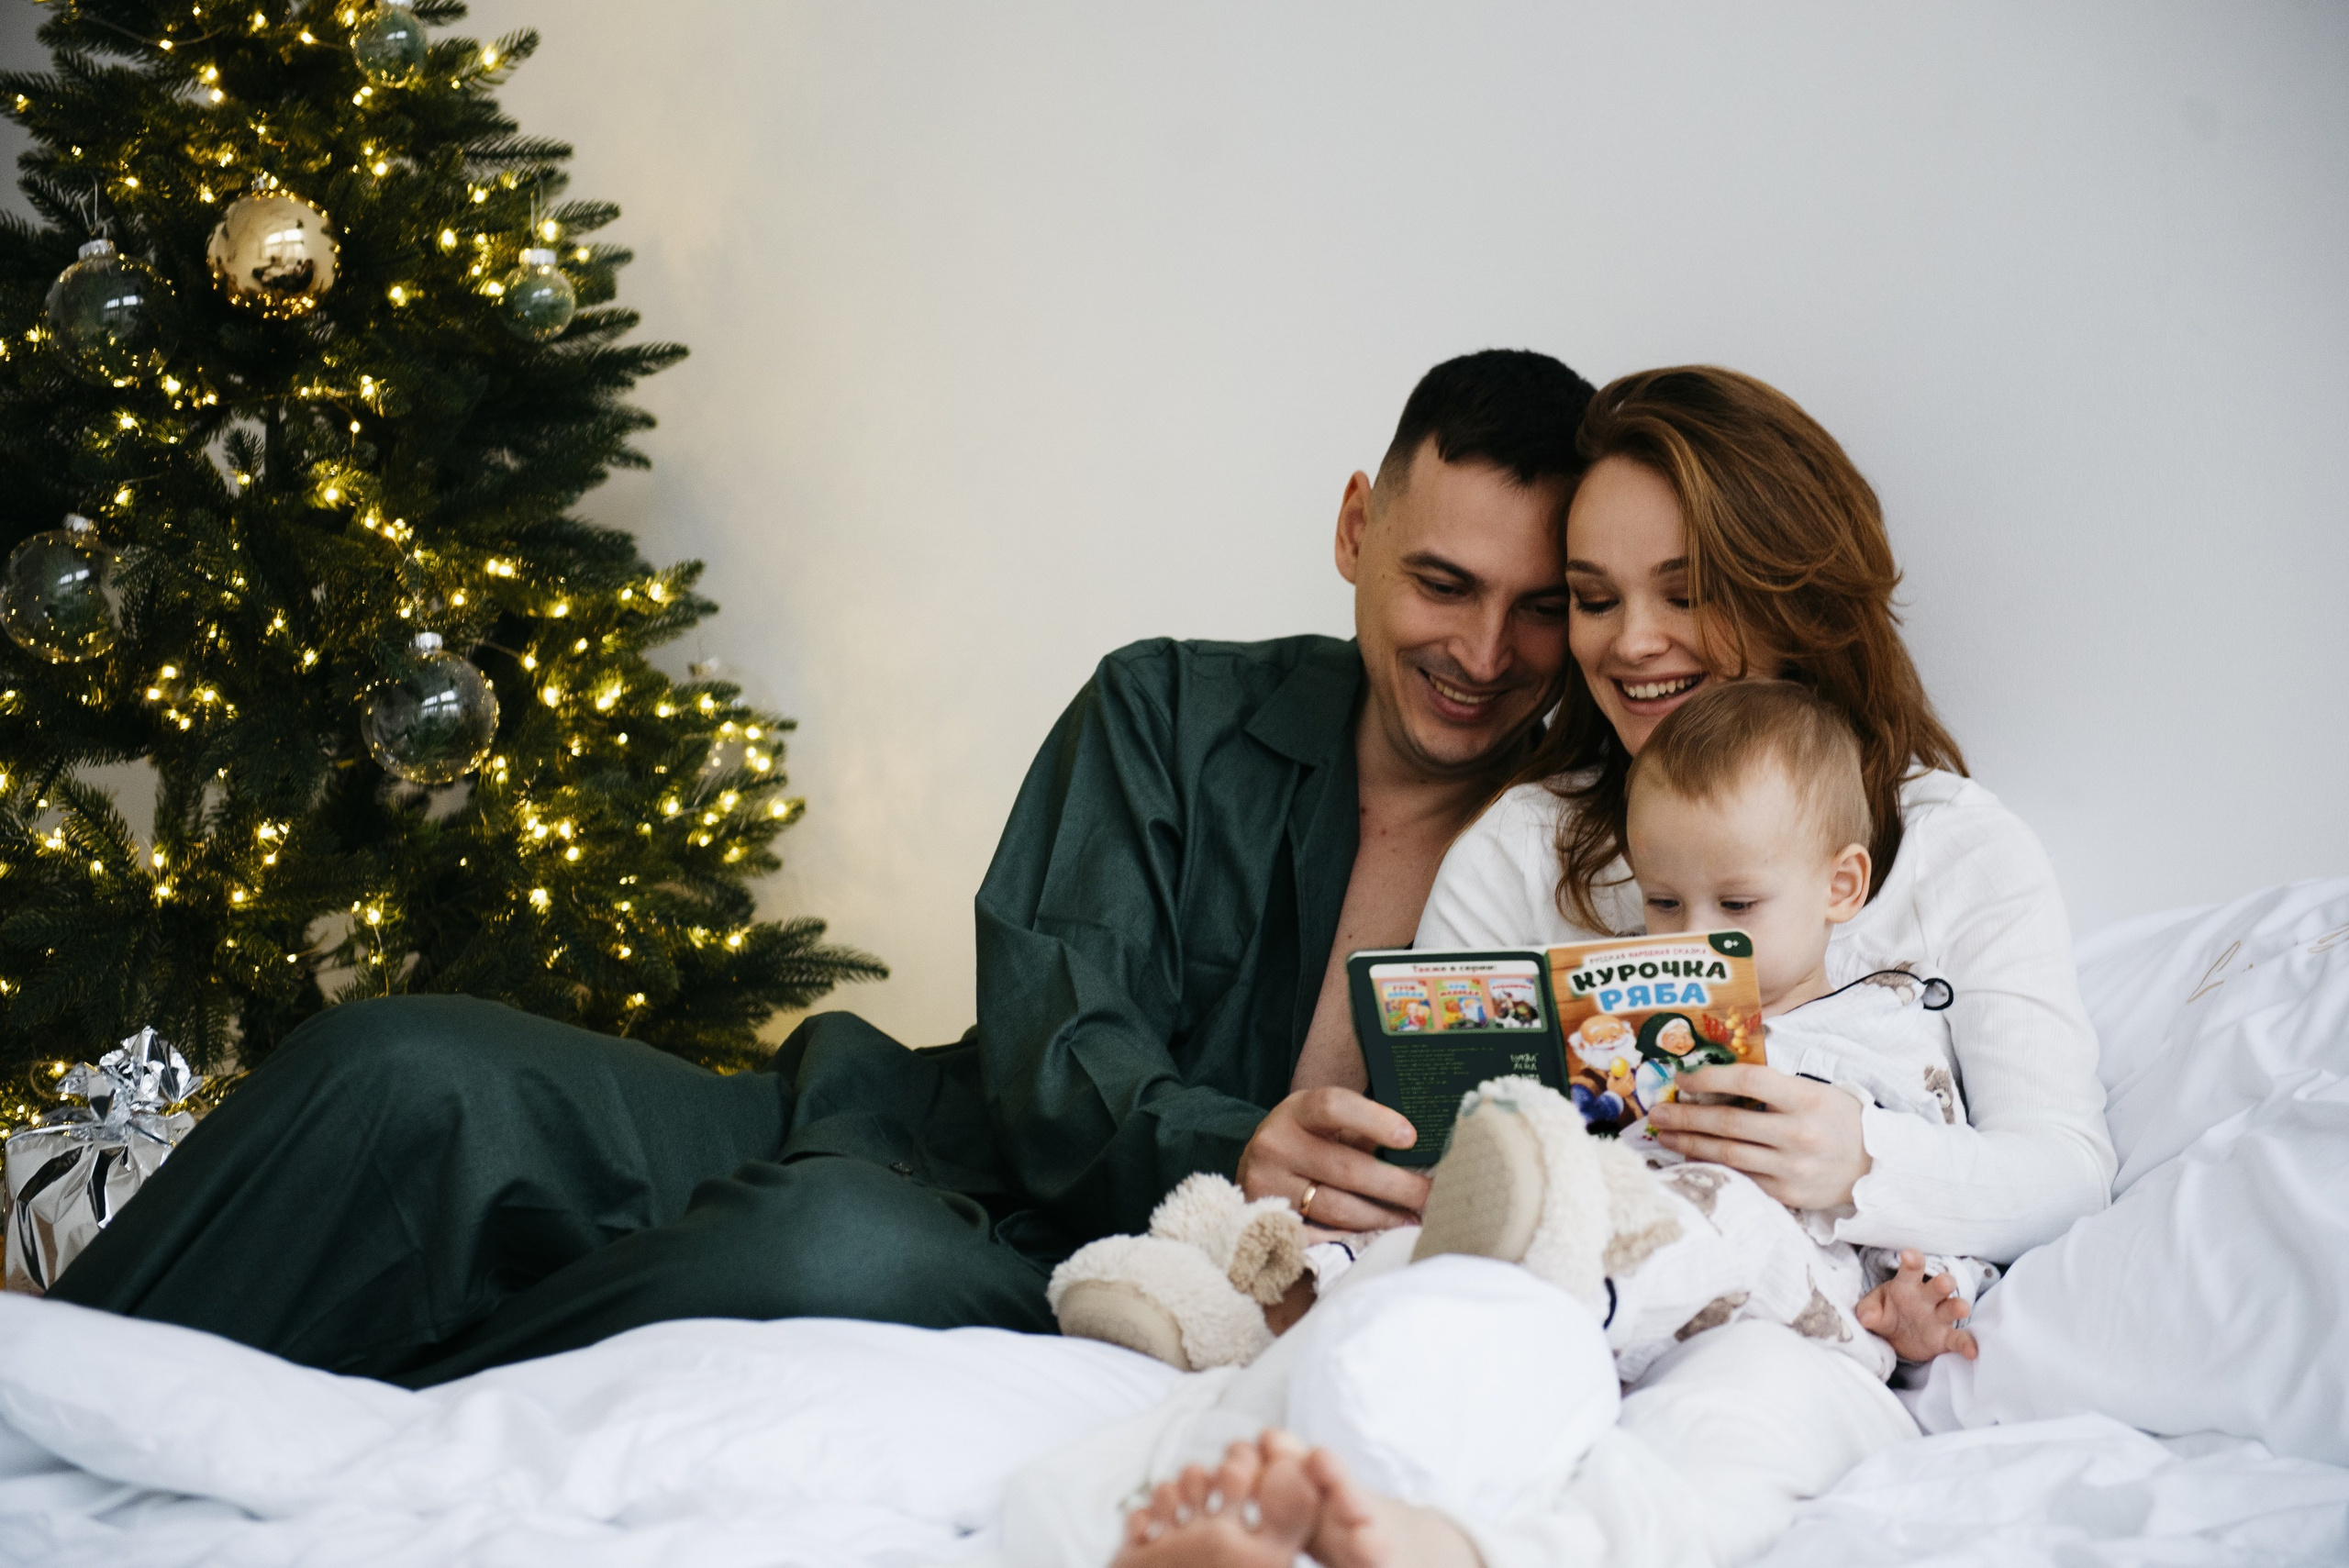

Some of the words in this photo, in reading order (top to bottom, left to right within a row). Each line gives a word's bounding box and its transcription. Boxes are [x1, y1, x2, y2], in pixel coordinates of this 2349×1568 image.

[1629, 948, 1670, 958] НАРОДНАЯ
[1673, 947, 1707, 955] СКАЗКА
[1572, 960, 1727, 992] КУРОЧКА
[1598, 983, 1707, 1011] РЯБА
